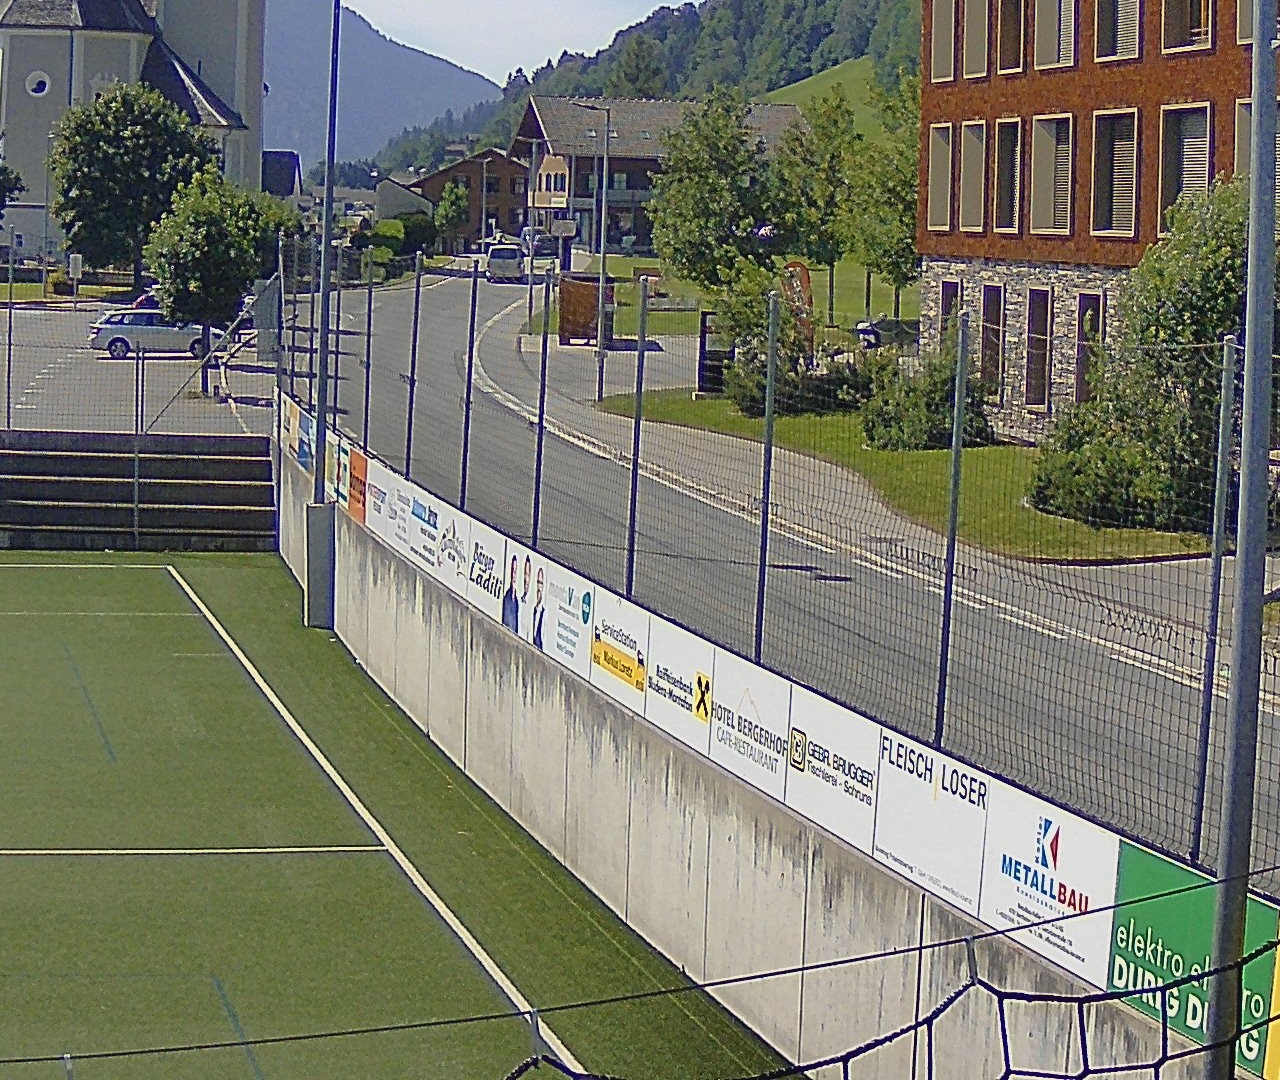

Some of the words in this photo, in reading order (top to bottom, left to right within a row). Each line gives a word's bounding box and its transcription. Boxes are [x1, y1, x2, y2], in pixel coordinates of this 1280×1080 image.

[656, 663, 693, 697] Raiffeisenbank
[710, 700, 736, 730] HOTEL
[737, 715, 789, 758] BERGERHOF
[806, 759, 838, 787] Tischlerei
[843, 780, 873, 807] Schruns
[832, 753, 874, 791] BRUGGER
[881, 735, 934, 784] FLEISCH
[941, 763, 988, 811] LOSER
[1001, 853, 1089, 914] METALLBAU
[1116, 917, 1184, 978] elektro
[1190, 954, 1265, 1019] elro
